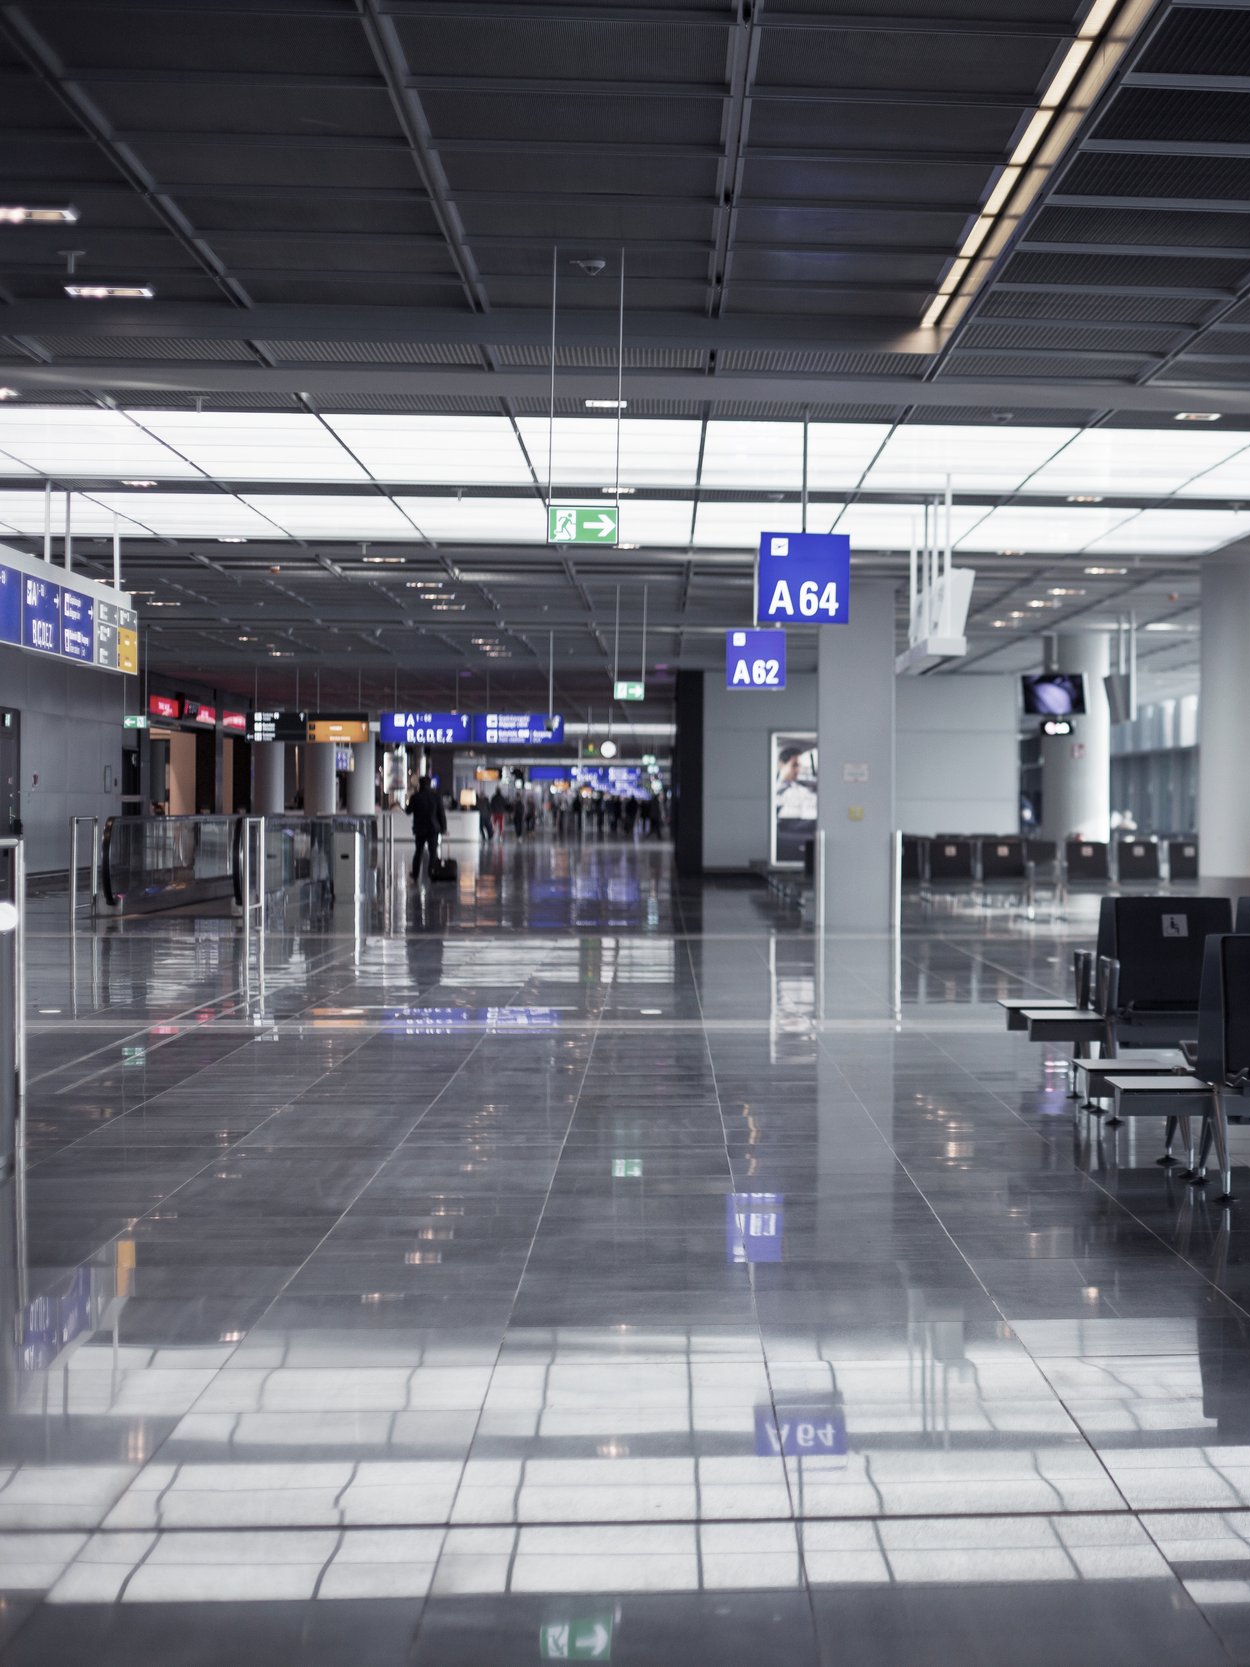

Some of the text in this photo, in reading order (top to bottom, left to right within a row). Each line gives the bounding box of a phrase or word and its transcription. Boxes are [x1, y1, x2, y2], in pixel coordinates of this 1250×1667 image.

[768, 580, 839, 617] A 64
[732, 659, 779, 684] A 62
